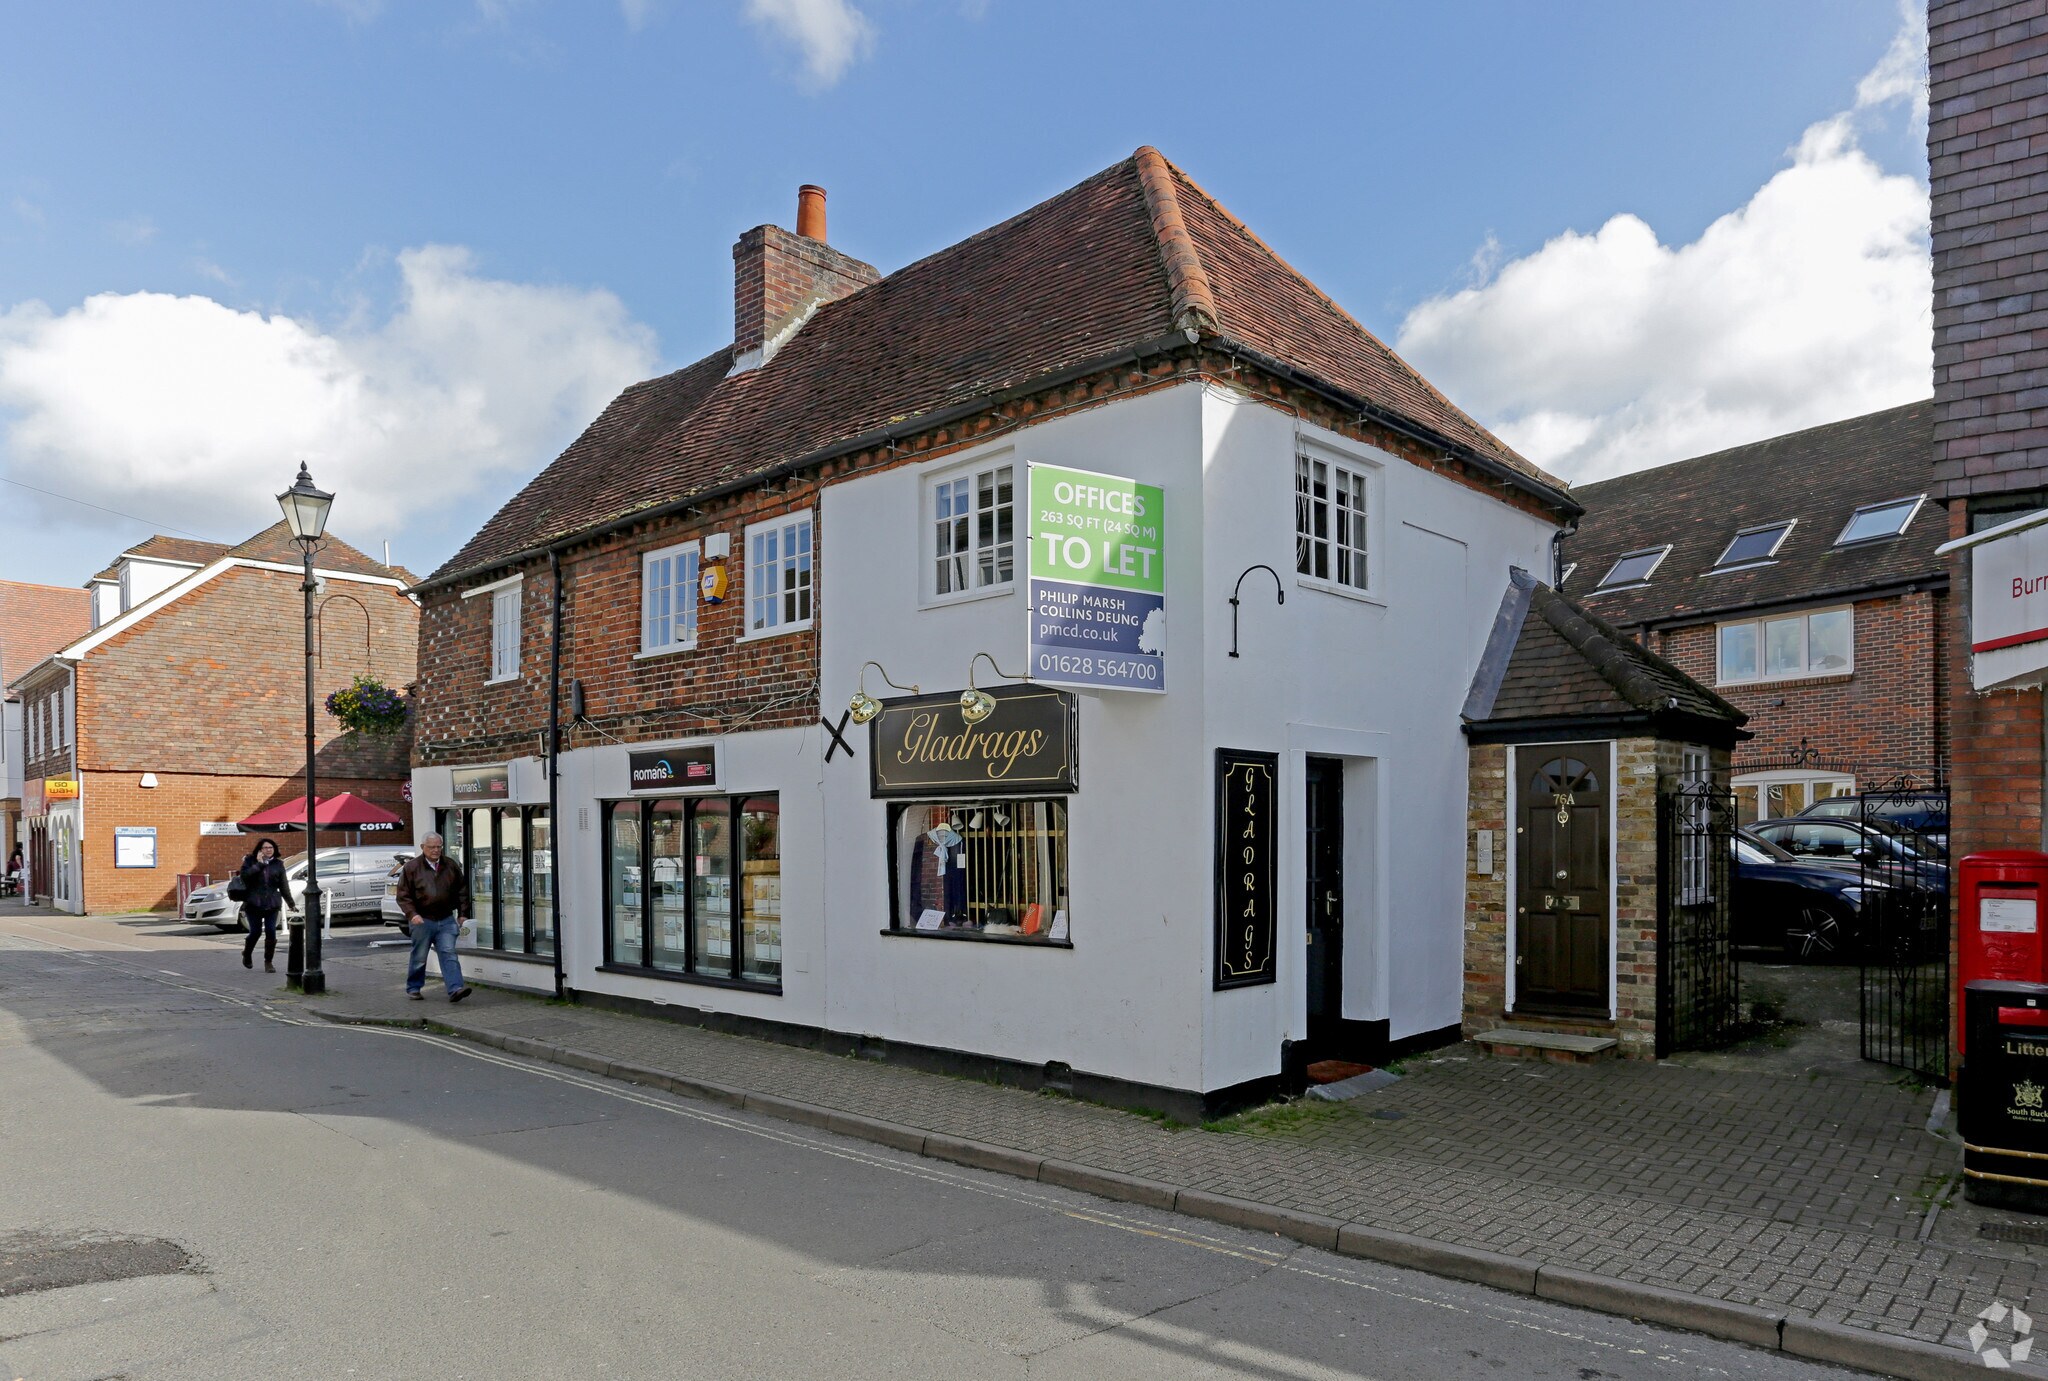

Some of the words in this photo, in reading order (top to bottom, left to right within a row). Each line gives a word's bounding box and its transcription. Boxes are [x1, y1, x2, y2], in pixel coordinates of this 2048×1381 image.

[1054, 481, 1146, 517] OFFICES
[1040, 510, 1064, 524] 263
[1066, 514, 1084, 529] SQ
[1086, 517, 1101, 529] FT
[1103, 518, 1122, 535] (24
[1124, 523, 1140, 538] SQ
[1142, 526, 1157, 542] M)
[1040, 531, 1092, 570] TO
[1103, 541, 1157, 579] LET
[1040, 589, 1079, 605] PHILIP
[1083, 595, 1126, 611] MARSH
[1040, 604, 1093, 621] COLLINS
[1096, 611, 1139, 627] DEUNG
[1040, 623, 1119, 642] pmcd.co.uk
[1039, 653, 1093, 675] 01628
[1097, 659, 1157, 681] 564700
[897, 709, 1049, 779] Gladrags
[1552, 793, 1575, 806] 76A
[359, 822, 394, 831] COSTA
[1242, 767, 1256, 970] GLADRAGS
[2006, 1106, 2029, 1117] South
